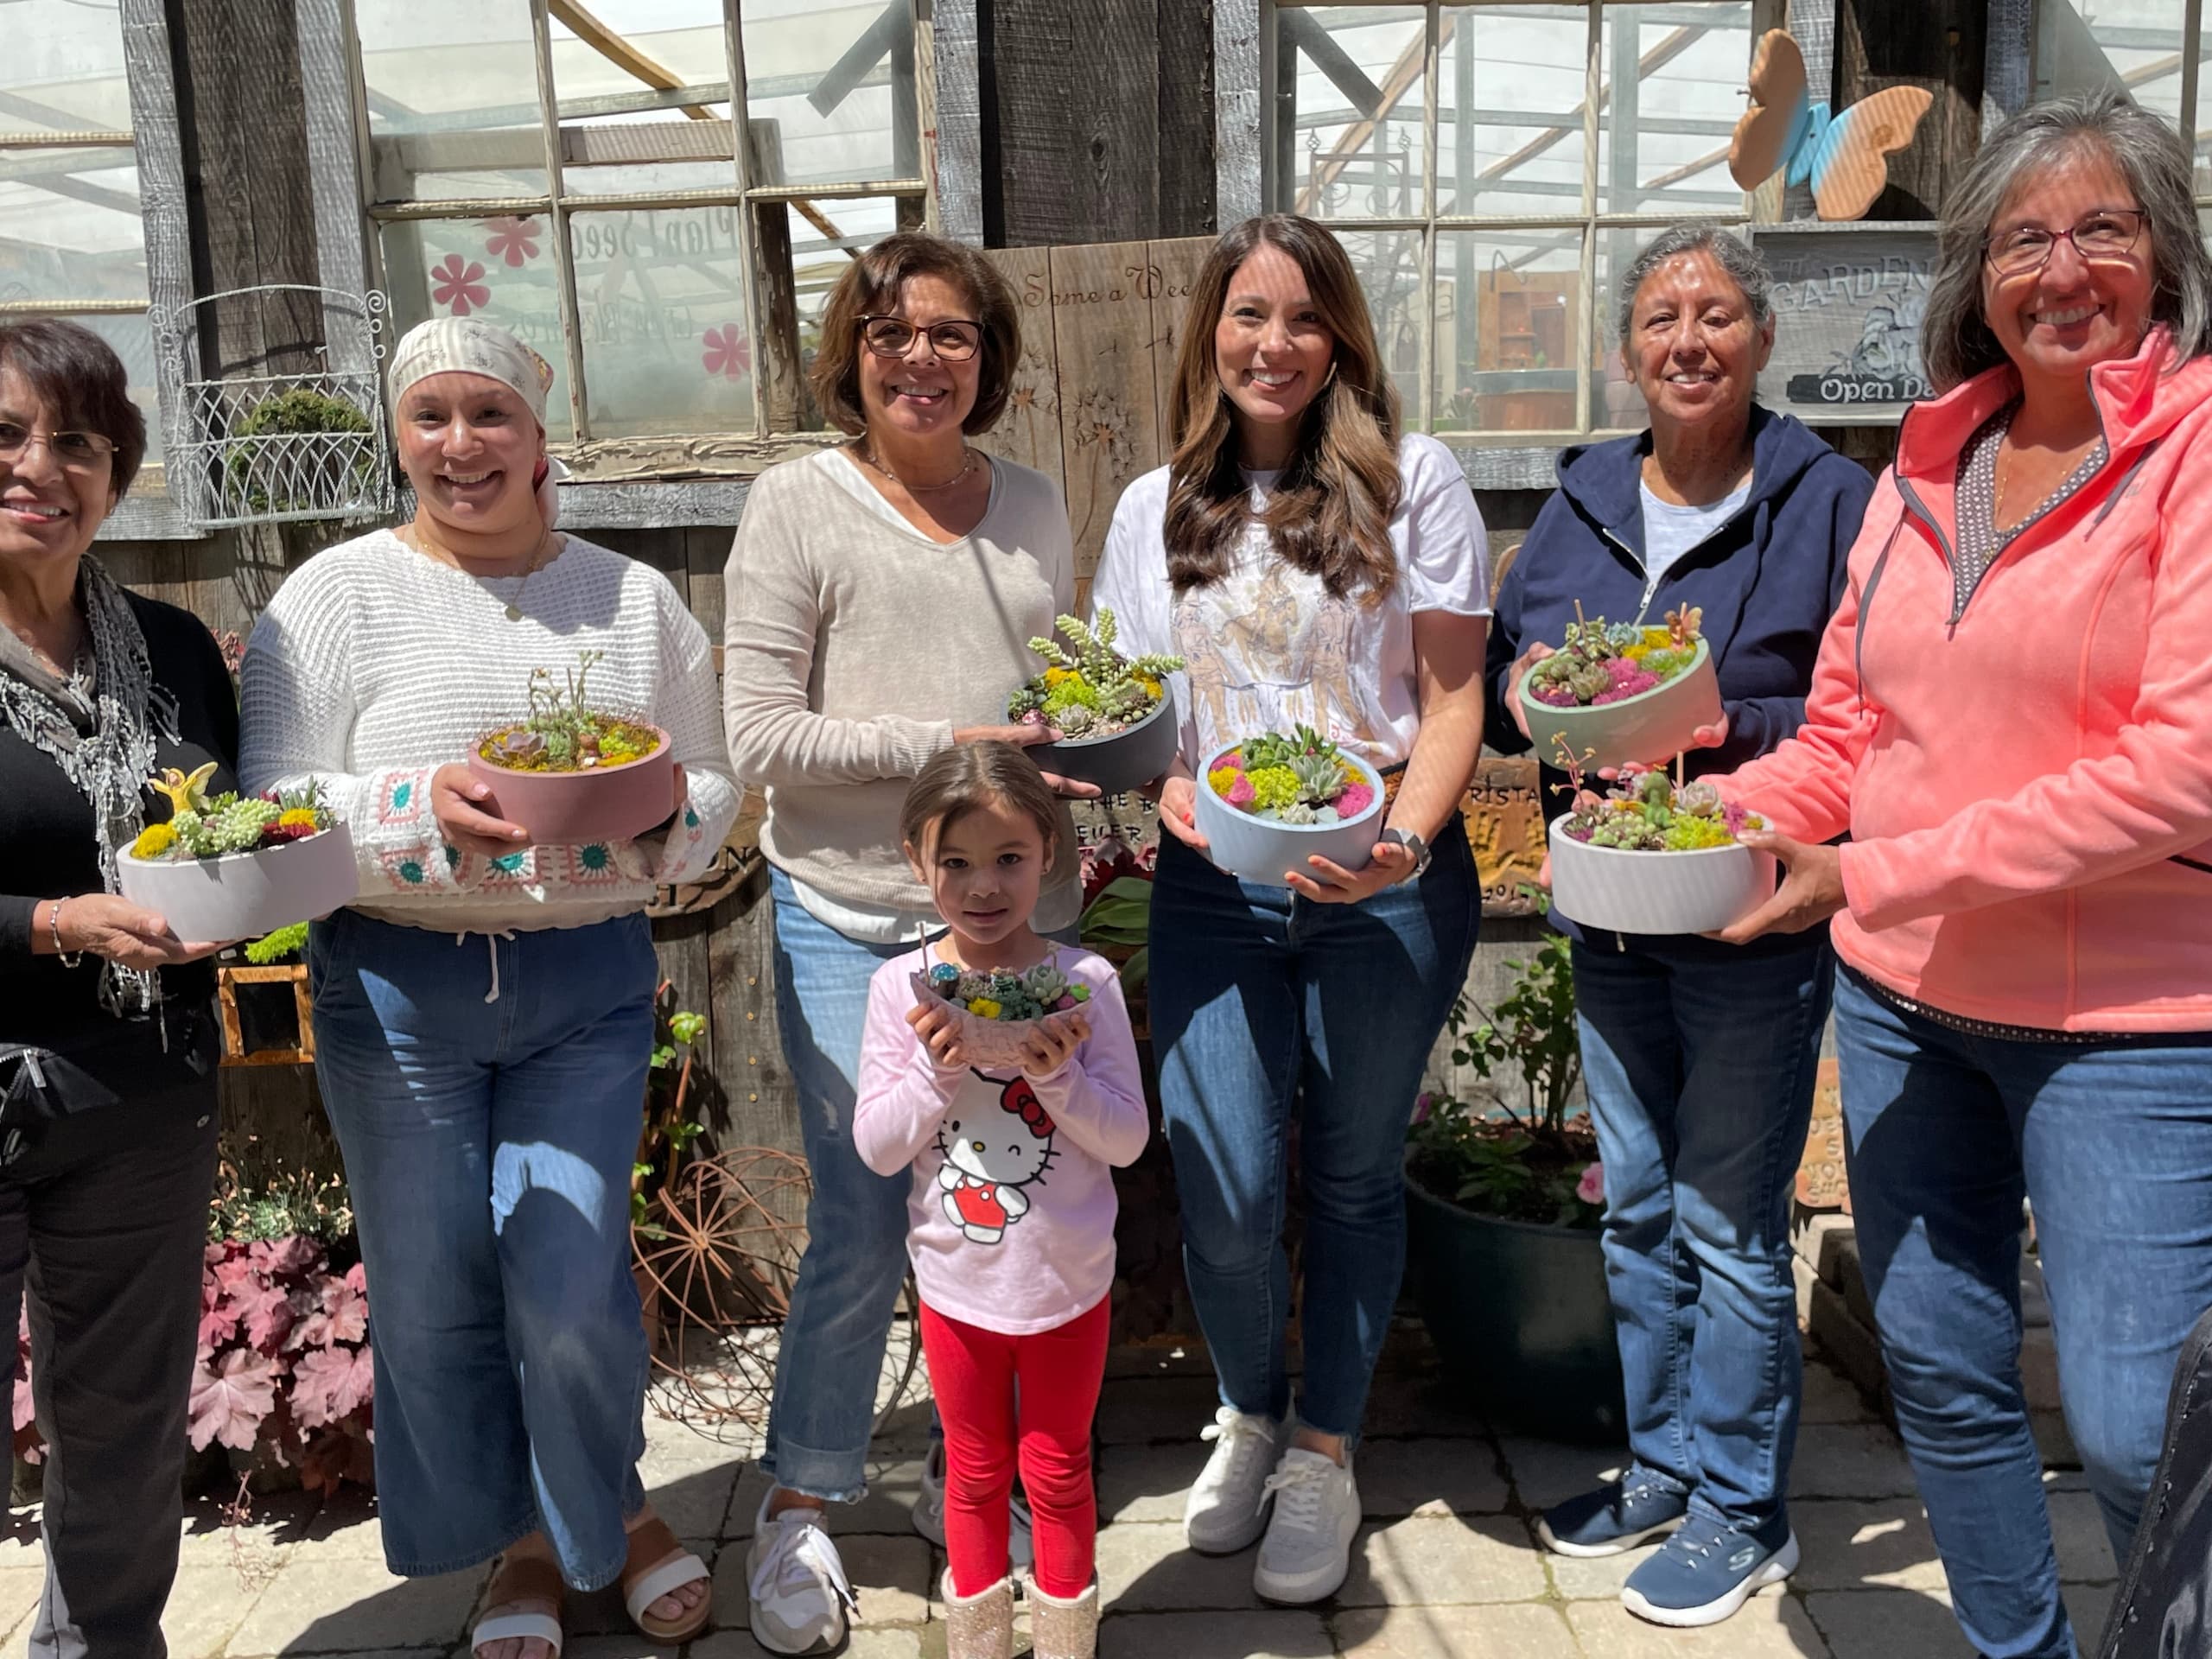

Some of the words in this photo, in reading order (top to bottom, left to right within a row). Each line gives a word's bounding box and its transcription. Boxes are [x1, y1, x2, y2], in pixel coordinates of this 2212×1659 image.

[1109, 289, 1127, 302] a
[1770, 257, 1934, 313] GARDEN
[1821, 379, 1894, 404] Open
